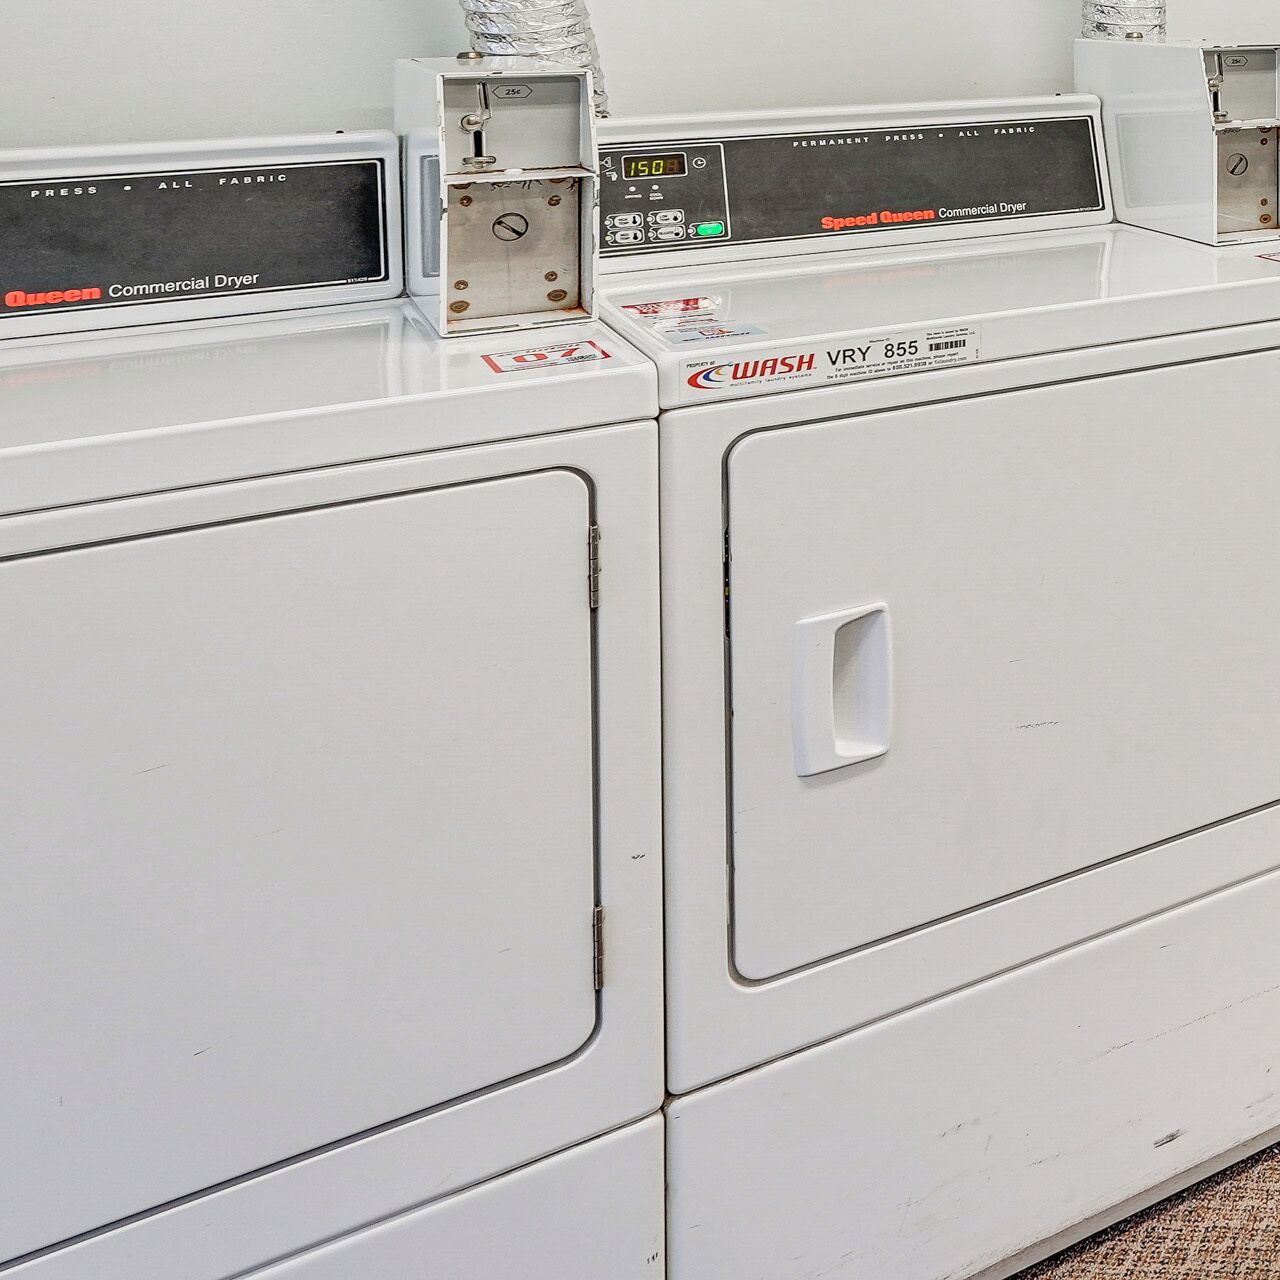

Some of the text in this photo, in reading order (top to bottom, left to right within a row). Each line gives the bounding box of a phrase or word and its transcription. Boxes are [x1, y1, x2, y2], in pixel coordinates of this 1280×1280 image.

[793, 126, 1036, 148] PERMANENT PRESS ALL FABRIC
[31, 174, 288, 198] PRESS ALL FABRIC
[821, 201, 1027, 231] Speed Queen Commercial Dryer
[4, 272, 260, 308] Queen Commercial Dryer
[826, 340, 918, 366] VRY 855
[732, 353, 815, 380] WASH
